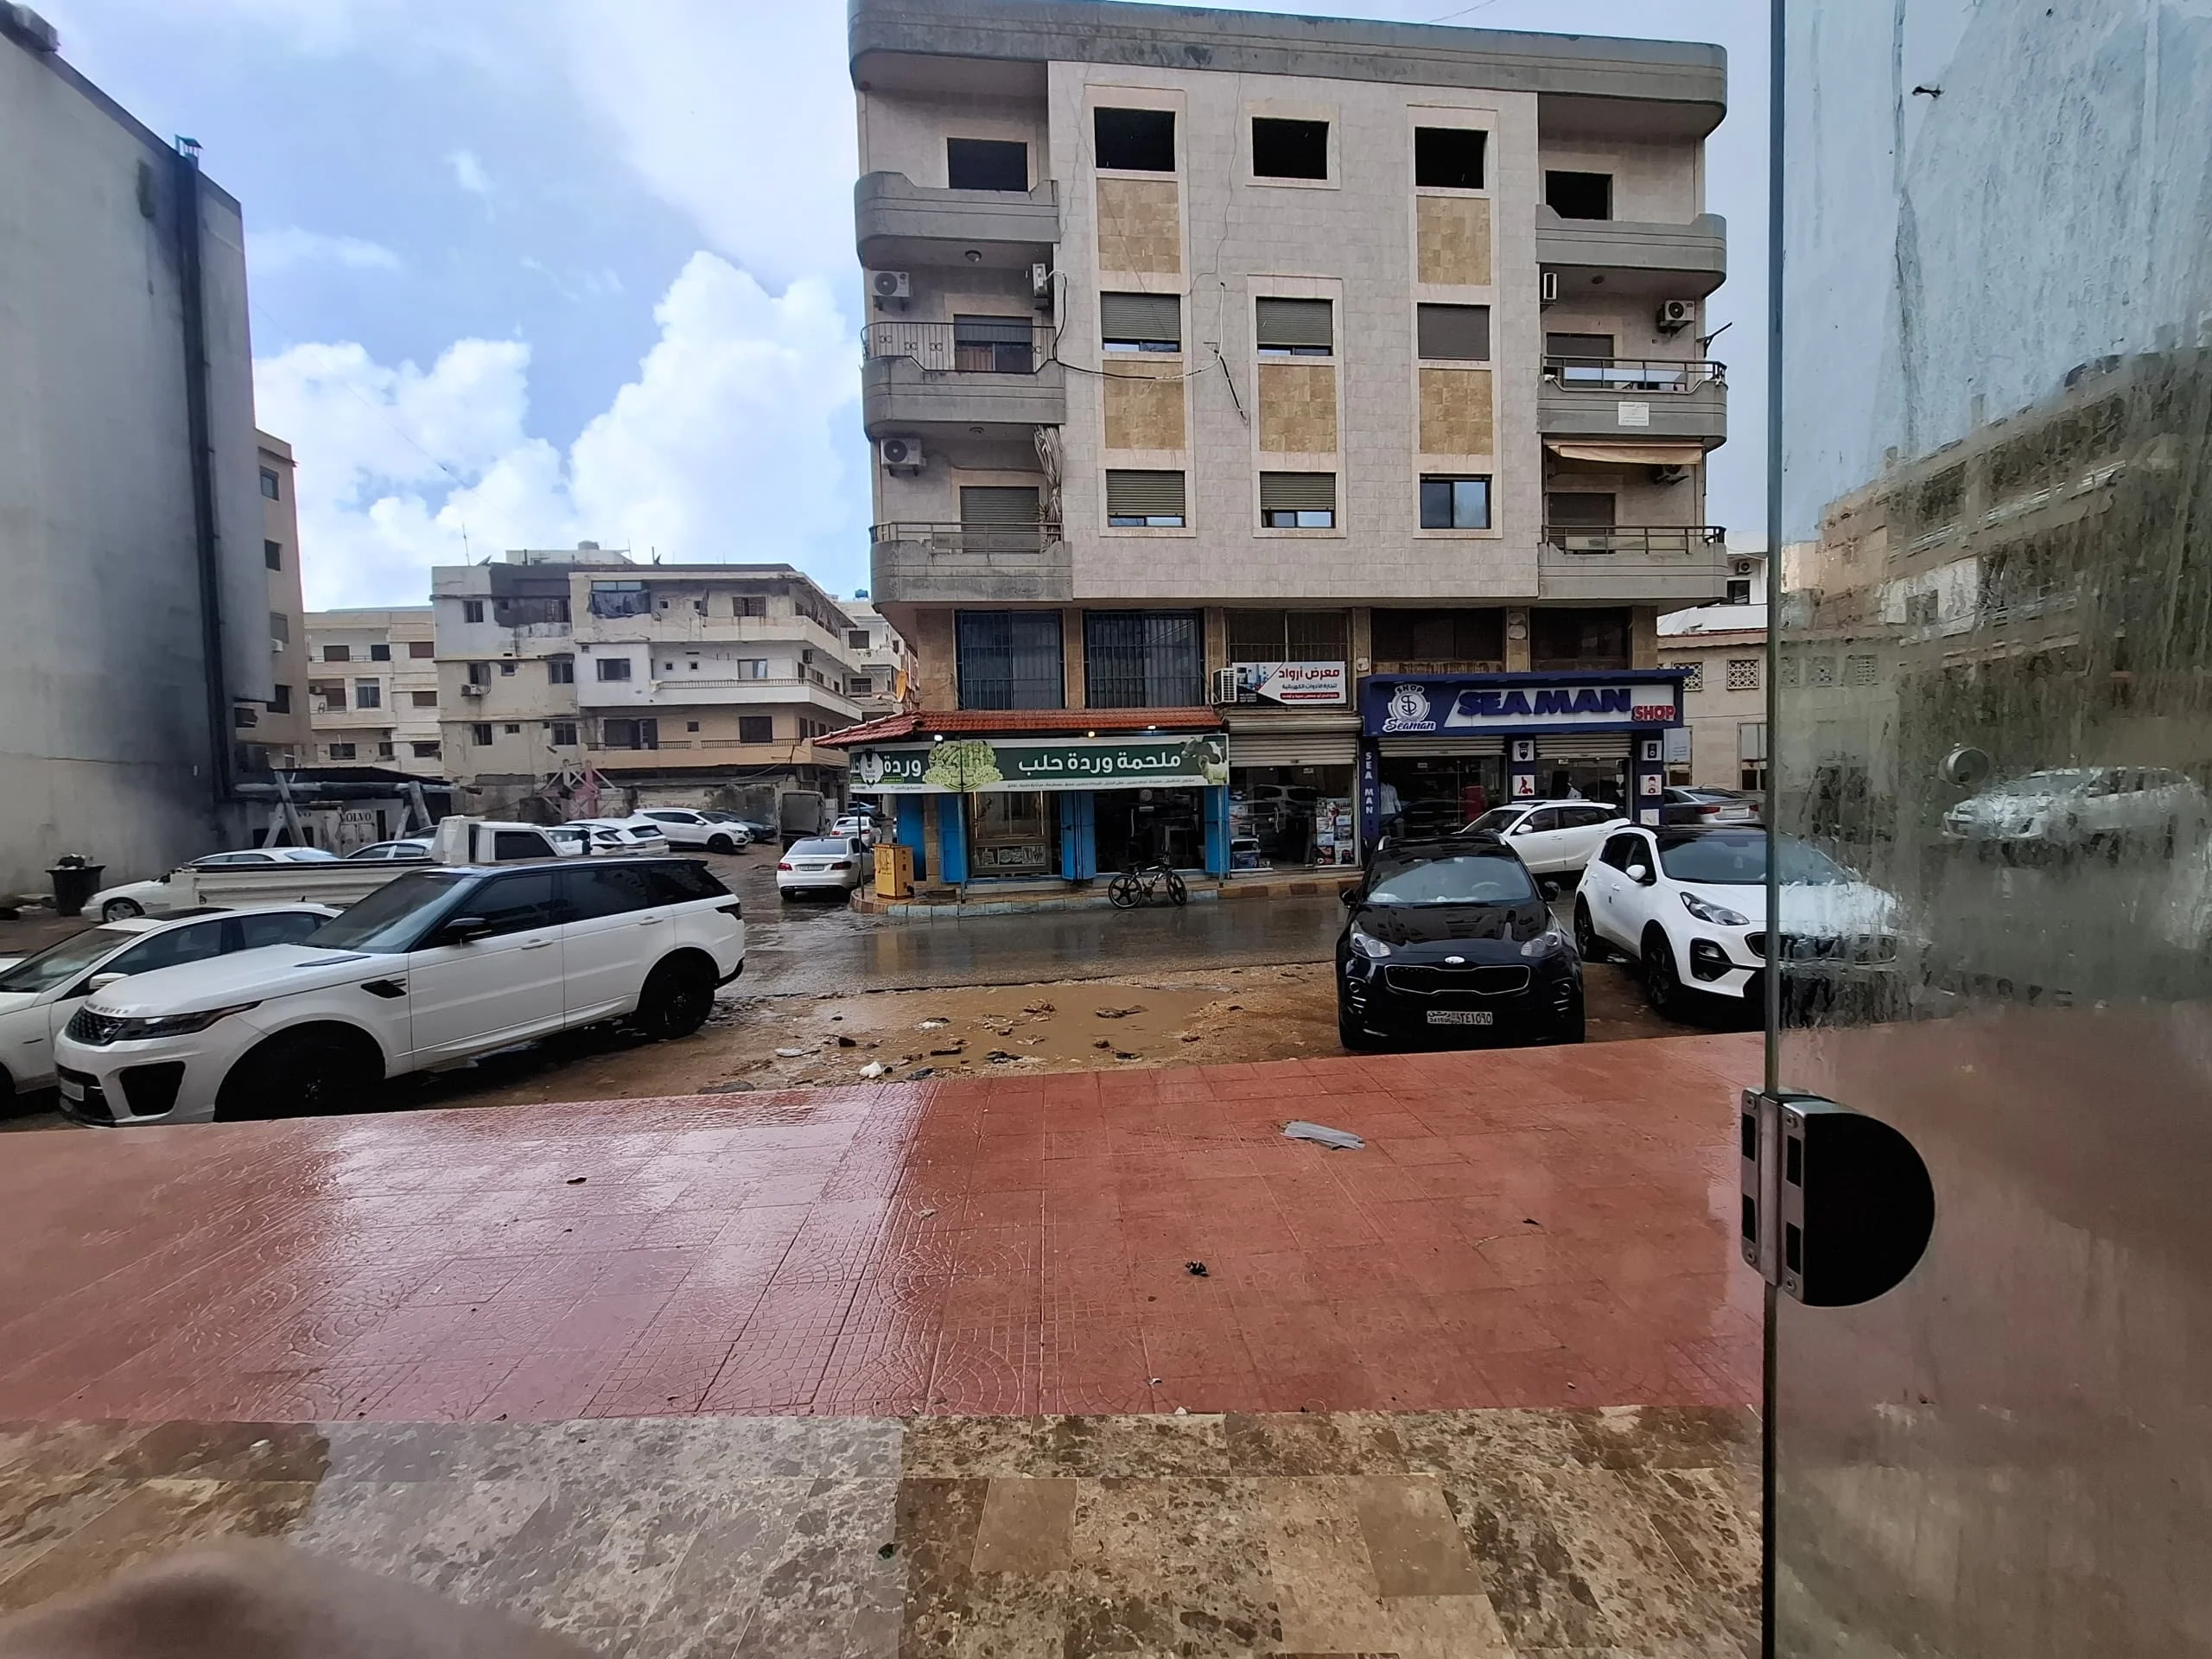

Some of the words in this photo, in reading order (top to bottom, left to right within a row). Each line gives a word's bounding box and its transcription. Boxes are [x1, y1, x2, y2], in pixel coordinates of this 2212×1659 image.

[1279, 665, 1303, 681] أرواد
[1306, 666, 1340, 681] معرض
[1395, 684, 1424, 694] SHOP
[1458, 689, 1631, 716] SEAMAN
[1631, 705, 1676, 722] SHOP
[1385, 718, 1435, 731] Seaman
[884, 754, 922, 778] وردة
[1018, 753, 1063, 776] حلب
[1067, 753, 1113, 774] وردة
[1117, 751, 1181, 770] ملحمة
[339, 811, 372, 823] VOLVO
